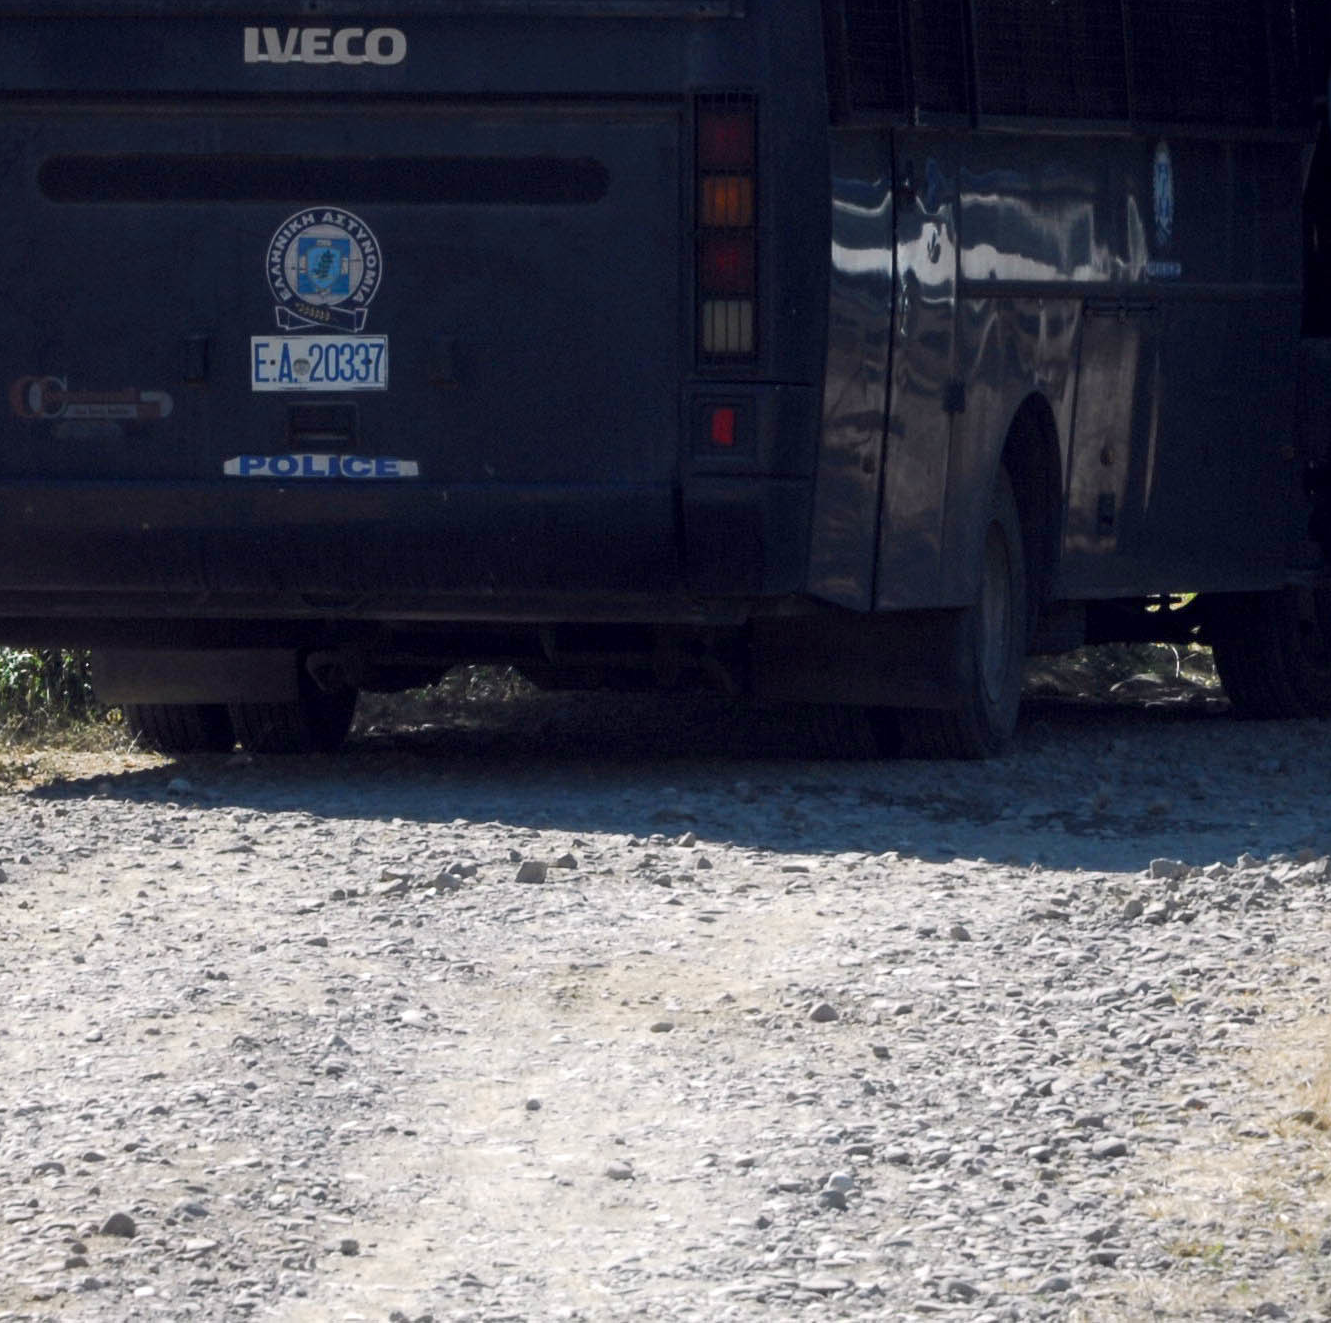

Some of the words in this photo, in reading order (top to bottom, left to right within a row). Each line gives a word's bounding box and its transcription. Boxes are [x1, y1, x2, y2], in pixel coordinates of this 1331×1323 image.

[243, 26, 408, 65] IVECO
[270, 212, 315, 302] ΕΛΛΗΝΙΚΗ
[321, 212, 378, 303] ΑΣΤΥΝΟΜΙΑ
[308, 342, 384, 383] 20337
[239, 455, 400, 477] POLICE
